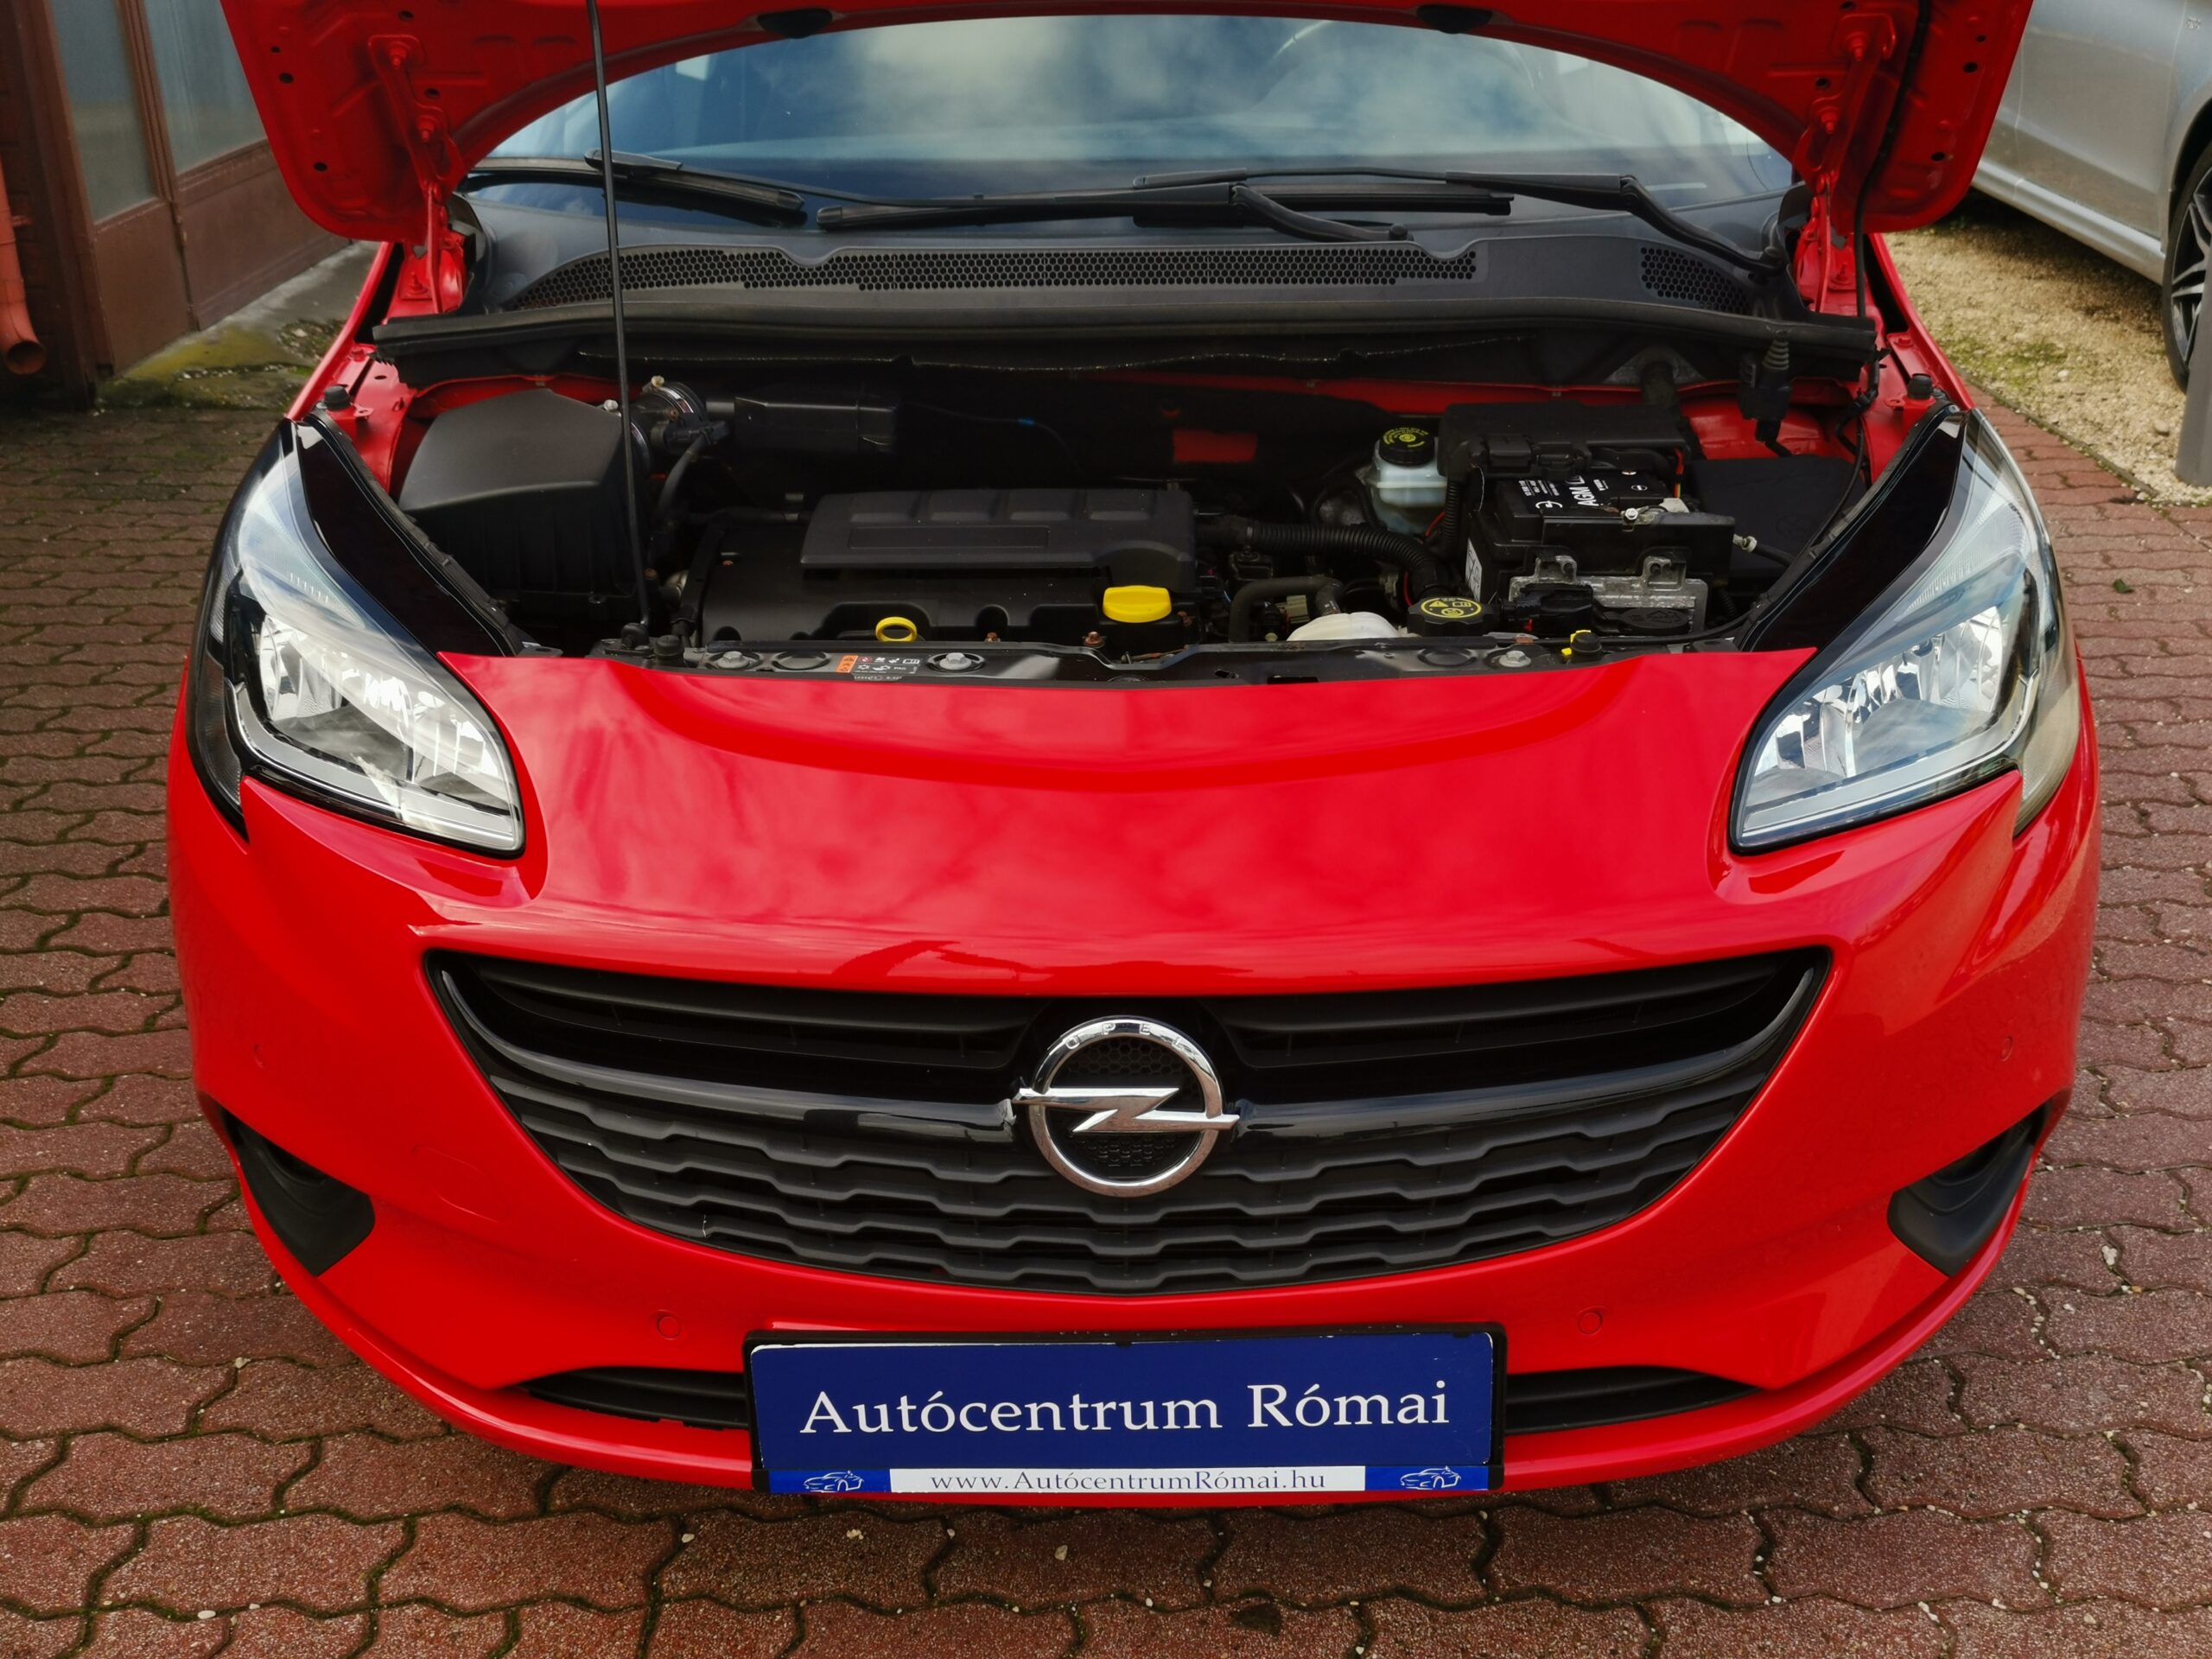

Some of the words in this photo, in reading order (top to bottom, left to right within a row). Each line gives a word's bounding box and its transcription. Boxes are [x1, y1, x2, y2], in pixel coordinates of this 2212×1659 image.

[1568, 486, 1599, 506] AGM
[1065, 1021, 1184, 1050] OPEL
[799, 1390, 1223, 1433] Autócentrum
[1247, 1380, 1450, 1427] Római
[931, 1470, 1325, 1491] www.AutócentrumRómai.hu
